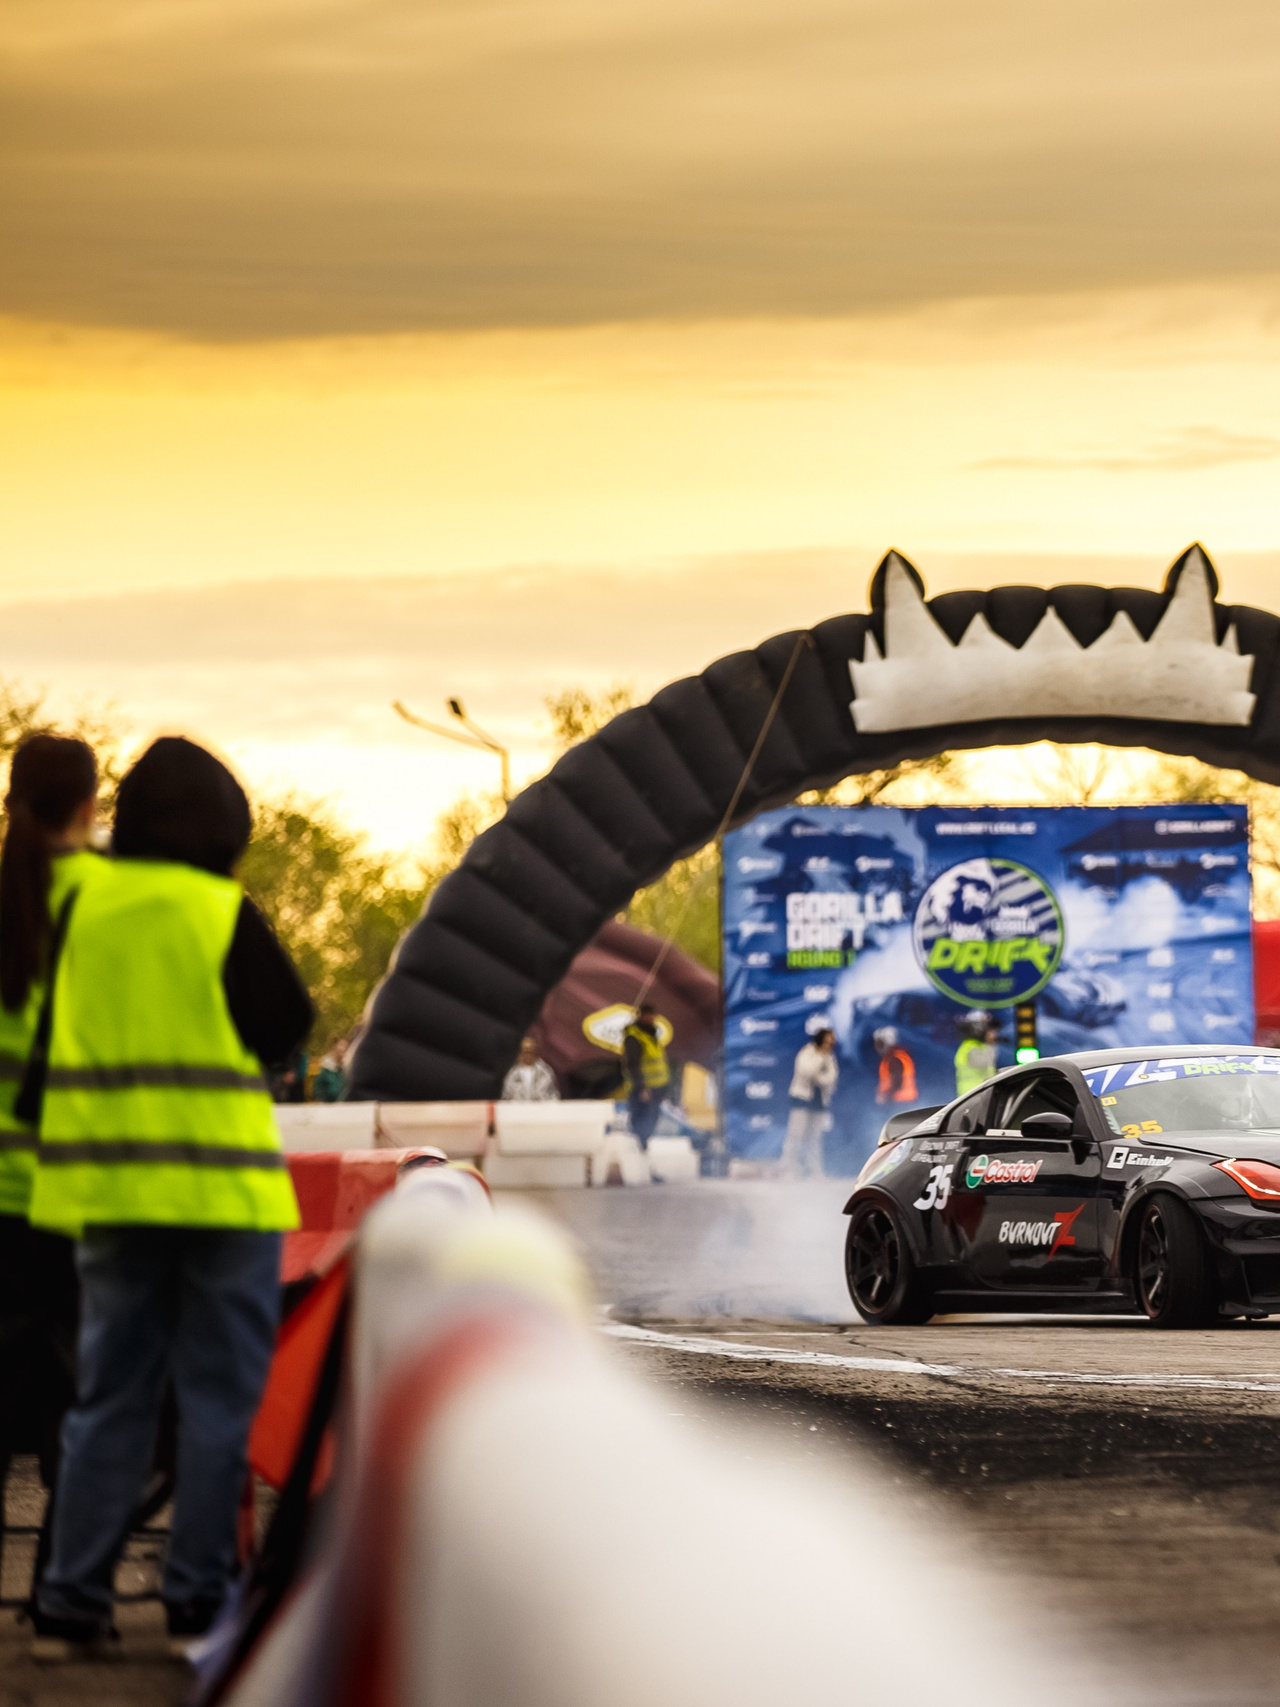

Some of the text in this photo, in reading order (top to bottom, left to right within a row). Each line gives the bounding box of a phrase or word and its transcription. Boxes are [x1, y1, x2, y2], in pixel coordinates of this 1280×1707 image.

[786, 891, 903, 922] GORILLA
[787, 922, 865, 949] DRIFT
[1121, 1120, 1163, 1138] 35
[984, 1160, 1043, 1183] Castrol
[913, 1164, 954, 1210] 35
